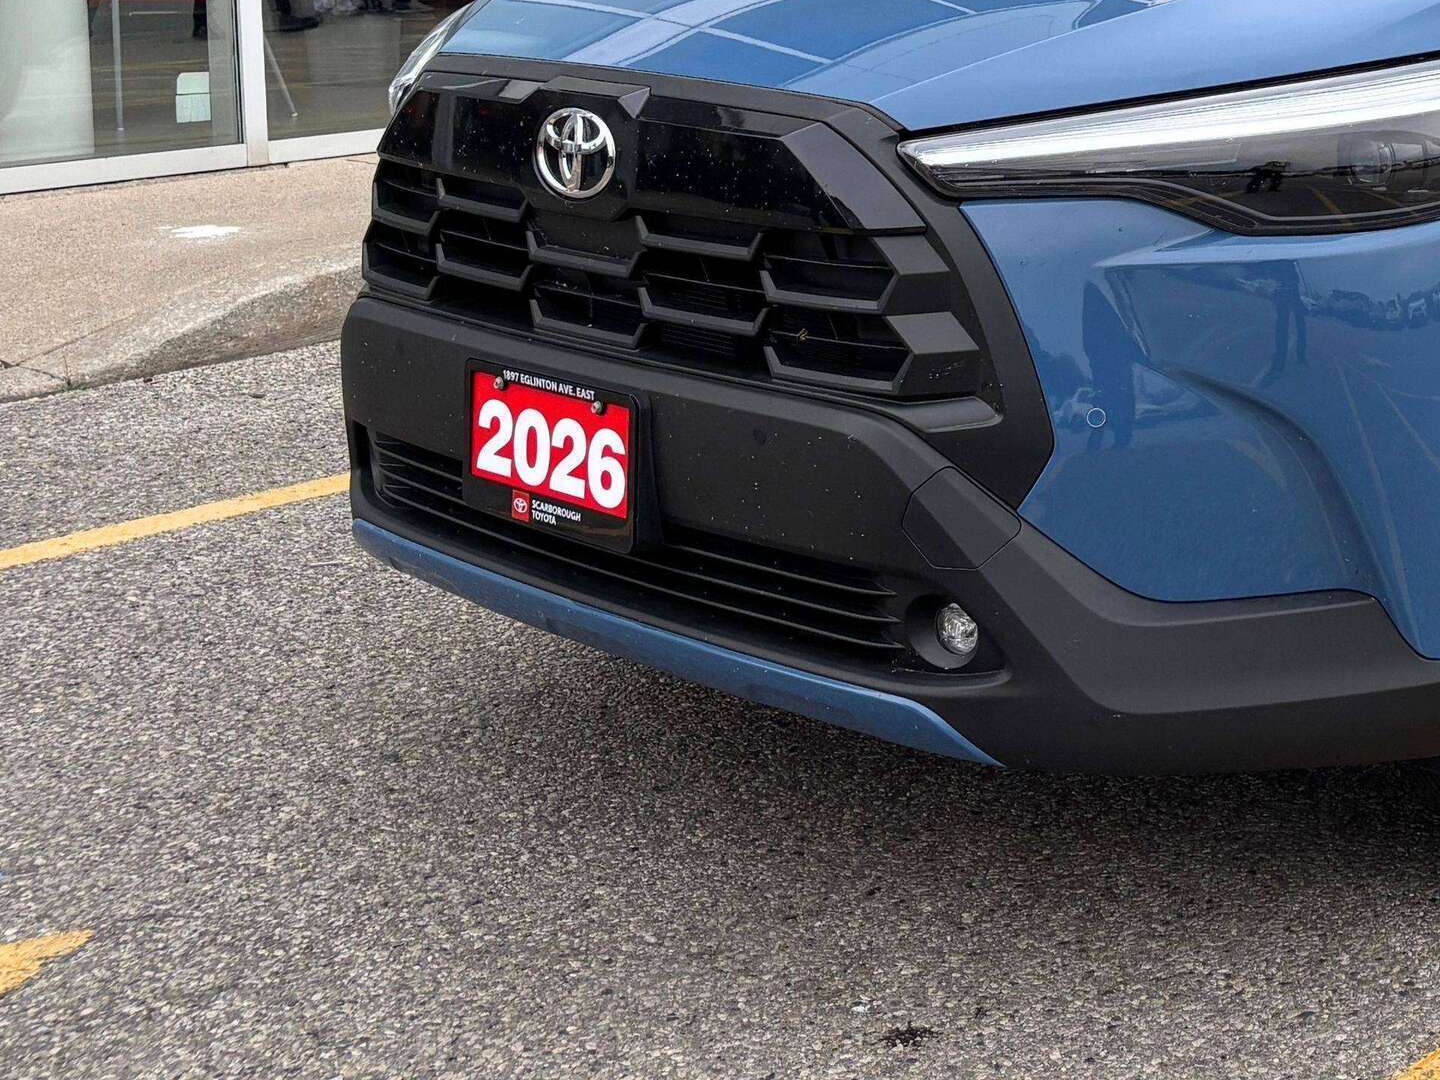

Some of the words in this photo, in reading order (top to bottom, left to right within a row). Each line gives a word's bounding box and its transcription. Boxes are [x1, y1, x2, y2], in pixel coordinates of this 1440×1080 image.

[502, 369, 520, 383] 1897
[520, 372, 557, 393] EGLINTON
[558, 382, 576, 396] AVE.
[576, 387, 596, 401] EAST
[476, 398, 627, 509] 2026
[531, 499, 582, 522] SCARBOROUGH
[532, 509, 557, 526] TOYOTA
